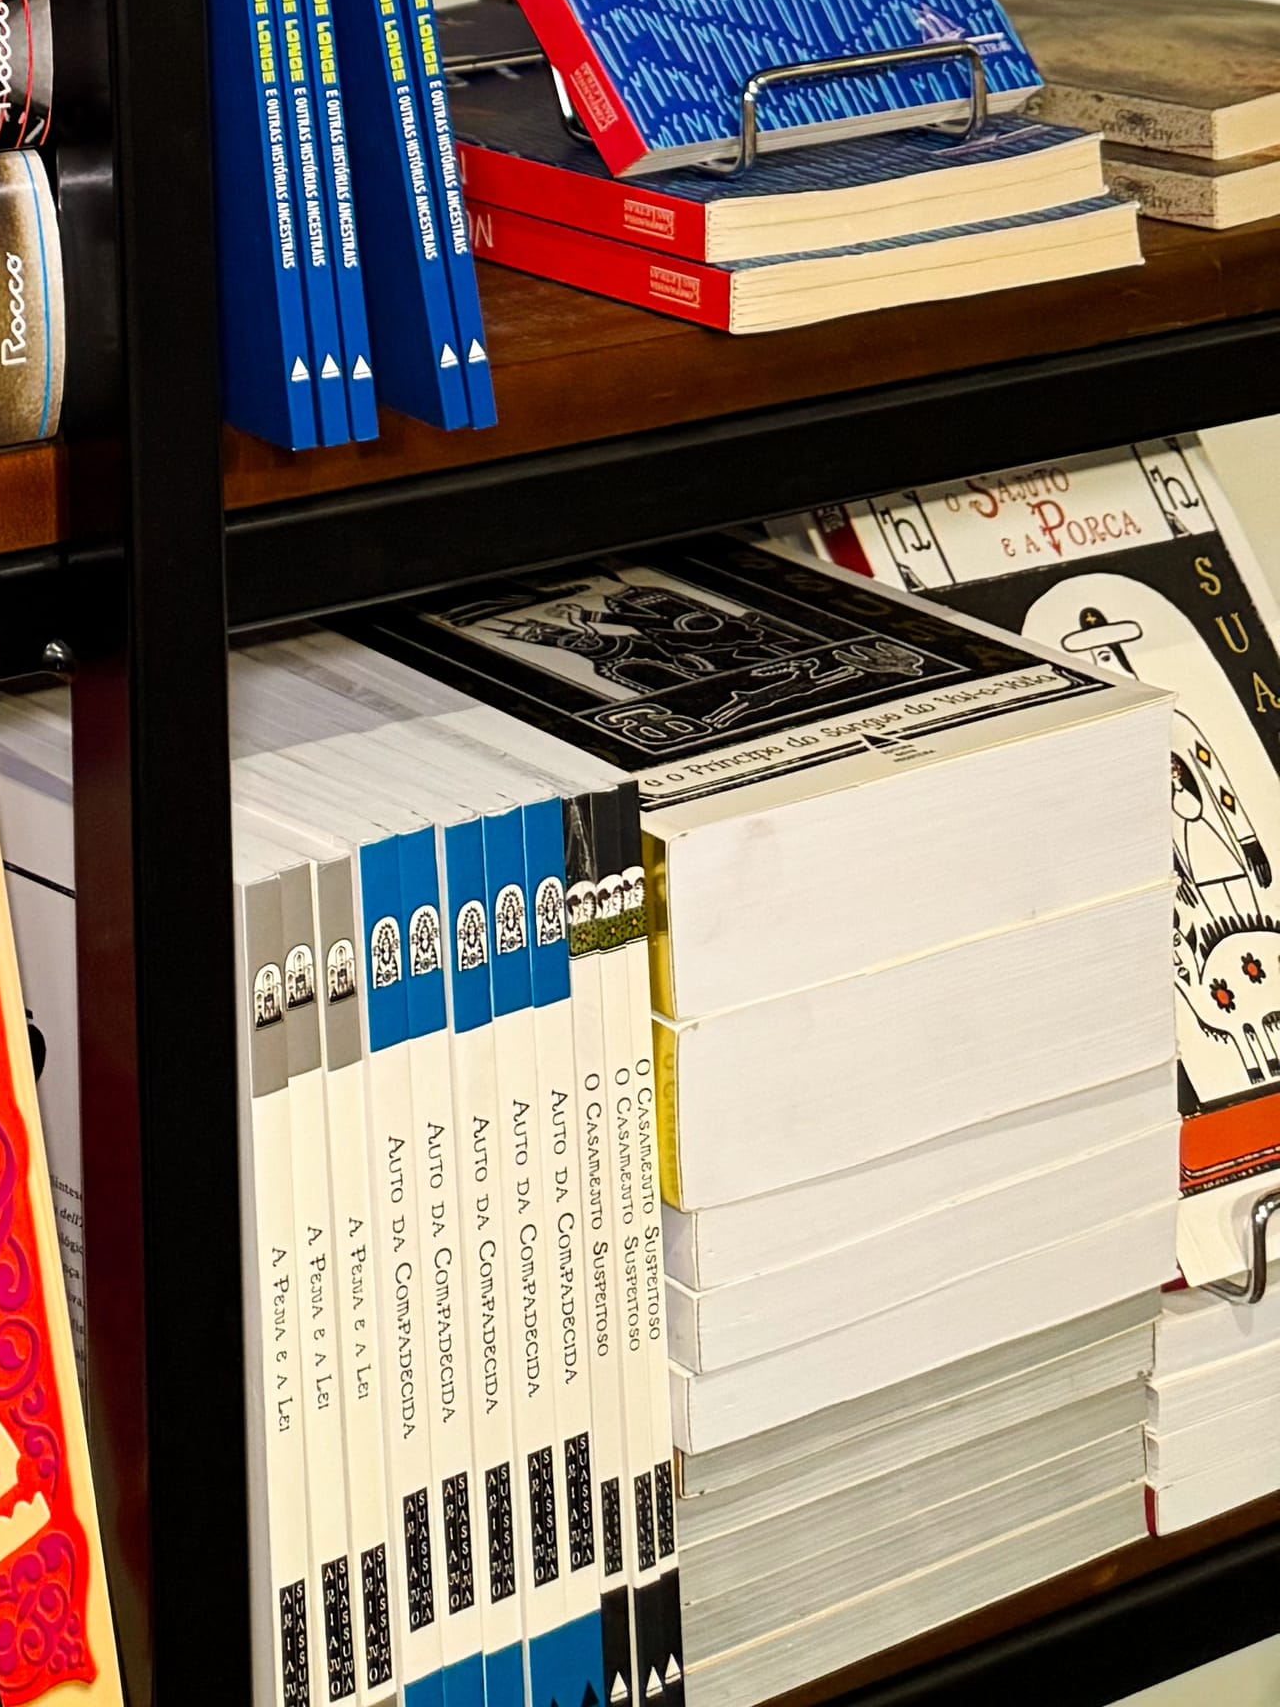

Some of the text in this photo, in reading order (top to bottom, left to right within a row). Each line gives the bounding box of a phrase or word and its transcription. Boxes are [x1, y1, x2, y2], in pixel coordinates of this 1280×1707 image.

[316, 21, 336, 84] LONGE
[1024, 534, 1040, 554] A
[1026, 499, 1142, 558] PORCA
